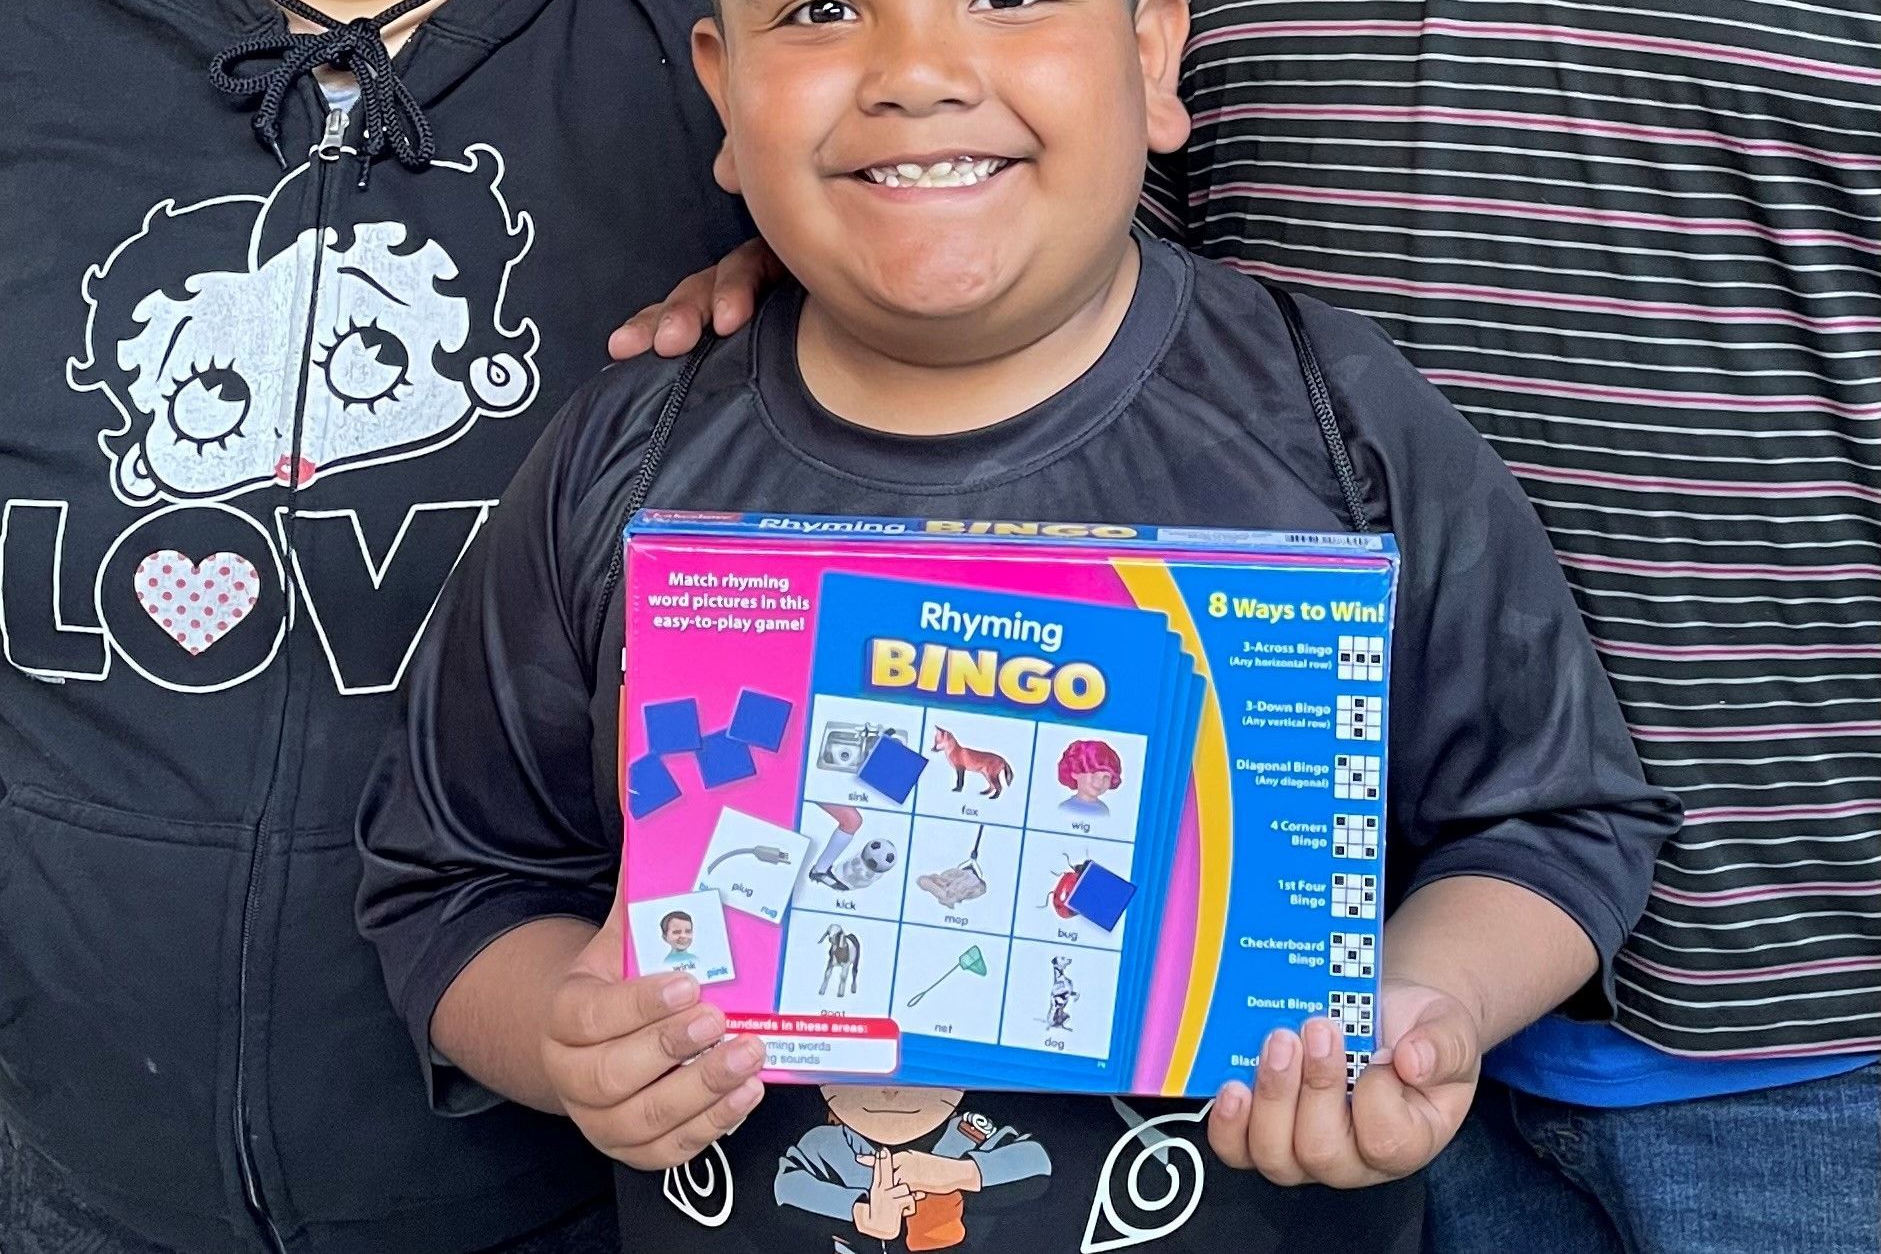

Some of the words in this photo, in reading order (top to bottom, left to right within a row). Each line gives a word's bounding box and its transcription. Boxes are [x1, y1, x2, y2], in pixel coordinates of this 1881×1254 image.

[758, 517, 906, 535] Rhyming
[926, 520, 1138, 539] BINGO
[668, 572, 718, 588] Match
[721, 573, 790, 593] rhyming
[0, 499, 499, 694] LOV
[648, 594, 690, 608] word
[692, 595, 758, 611] pictures
[761, 596, 777, 610] in
[779, 596, 810, 611] this
[1208, 591, 1228, 618] 8
[1232, 597, 1296, 624] Ways
[1300, 601, 1326, 621] to
[1330, 601, 1386, 624] Win!
[653, 615, 752, 632] easy-to-play
[754, 617, 806, 633] game!
[920, 600, 1064, 653] Rhyming
[1243, 641, 1295, 654] 3-Across
[1297, 643, 1333, 657] Bingo
[1229, 656, 1252, 667] (Any
[1255, 657, 1308, 668] horizontal
[1309, 660, 1333, 670] row)
[871, 638, 1107, 711] BINGO
[1245, 700, 1293, 712] 3-Down
[1295, 702, 1331, 717] Bingo
[1242, 715, 1266, 727] (Any
[1268, 717, 1306, 728] vertical
[1307, 719, 1331, 730] row)
[1236, 759, 1291, 774] Diagonal
[1293, 761, 1330, 775] Bingo
[1255, 775, 1279, 787] (Any
[1280, 776, 1329, 788] diagonal)
[848, 791, 869, 803] sink
[961, 805, 979, 817] fox
[1071, 820, 1091, 833] wig
[1270, 820, 1279, 831] 4
[1280, 820, 1327, 833] Corners
[1291, 834, 1328, 850] Bingo
[731, 882, 754, 898] plug
[1278, 879, 1296, 891] 1st
[1298, 880, 1327, 892] Four
[835, 898, 857, 911] kick
[1290, 894, 1326, 909] Bingo
[760, 905, 778, 919] rug
[944, 913, 969, 927] mop
[1057, 927, 1078, 941] bug
[1240, 936, 1325, 952] Checkerboard
[1288, 953, 1325, 967] Bingo
[706, 965, 729, 979] pink
[1247, 996, 1286, 1009] Donut
[1288, 998, 1324, 1012] Bingo
[725, 1019, 779, 1031] tandards
[782, 1020, 793, 1031] in
[795, 1020, 829, 1032] these
[934, 1022, 953, 1034] net
[798, 1041, 831, 1052] words
[1044, 1036, 1065, 1051] dog
[780, 1054, 821, 1065] sounds
